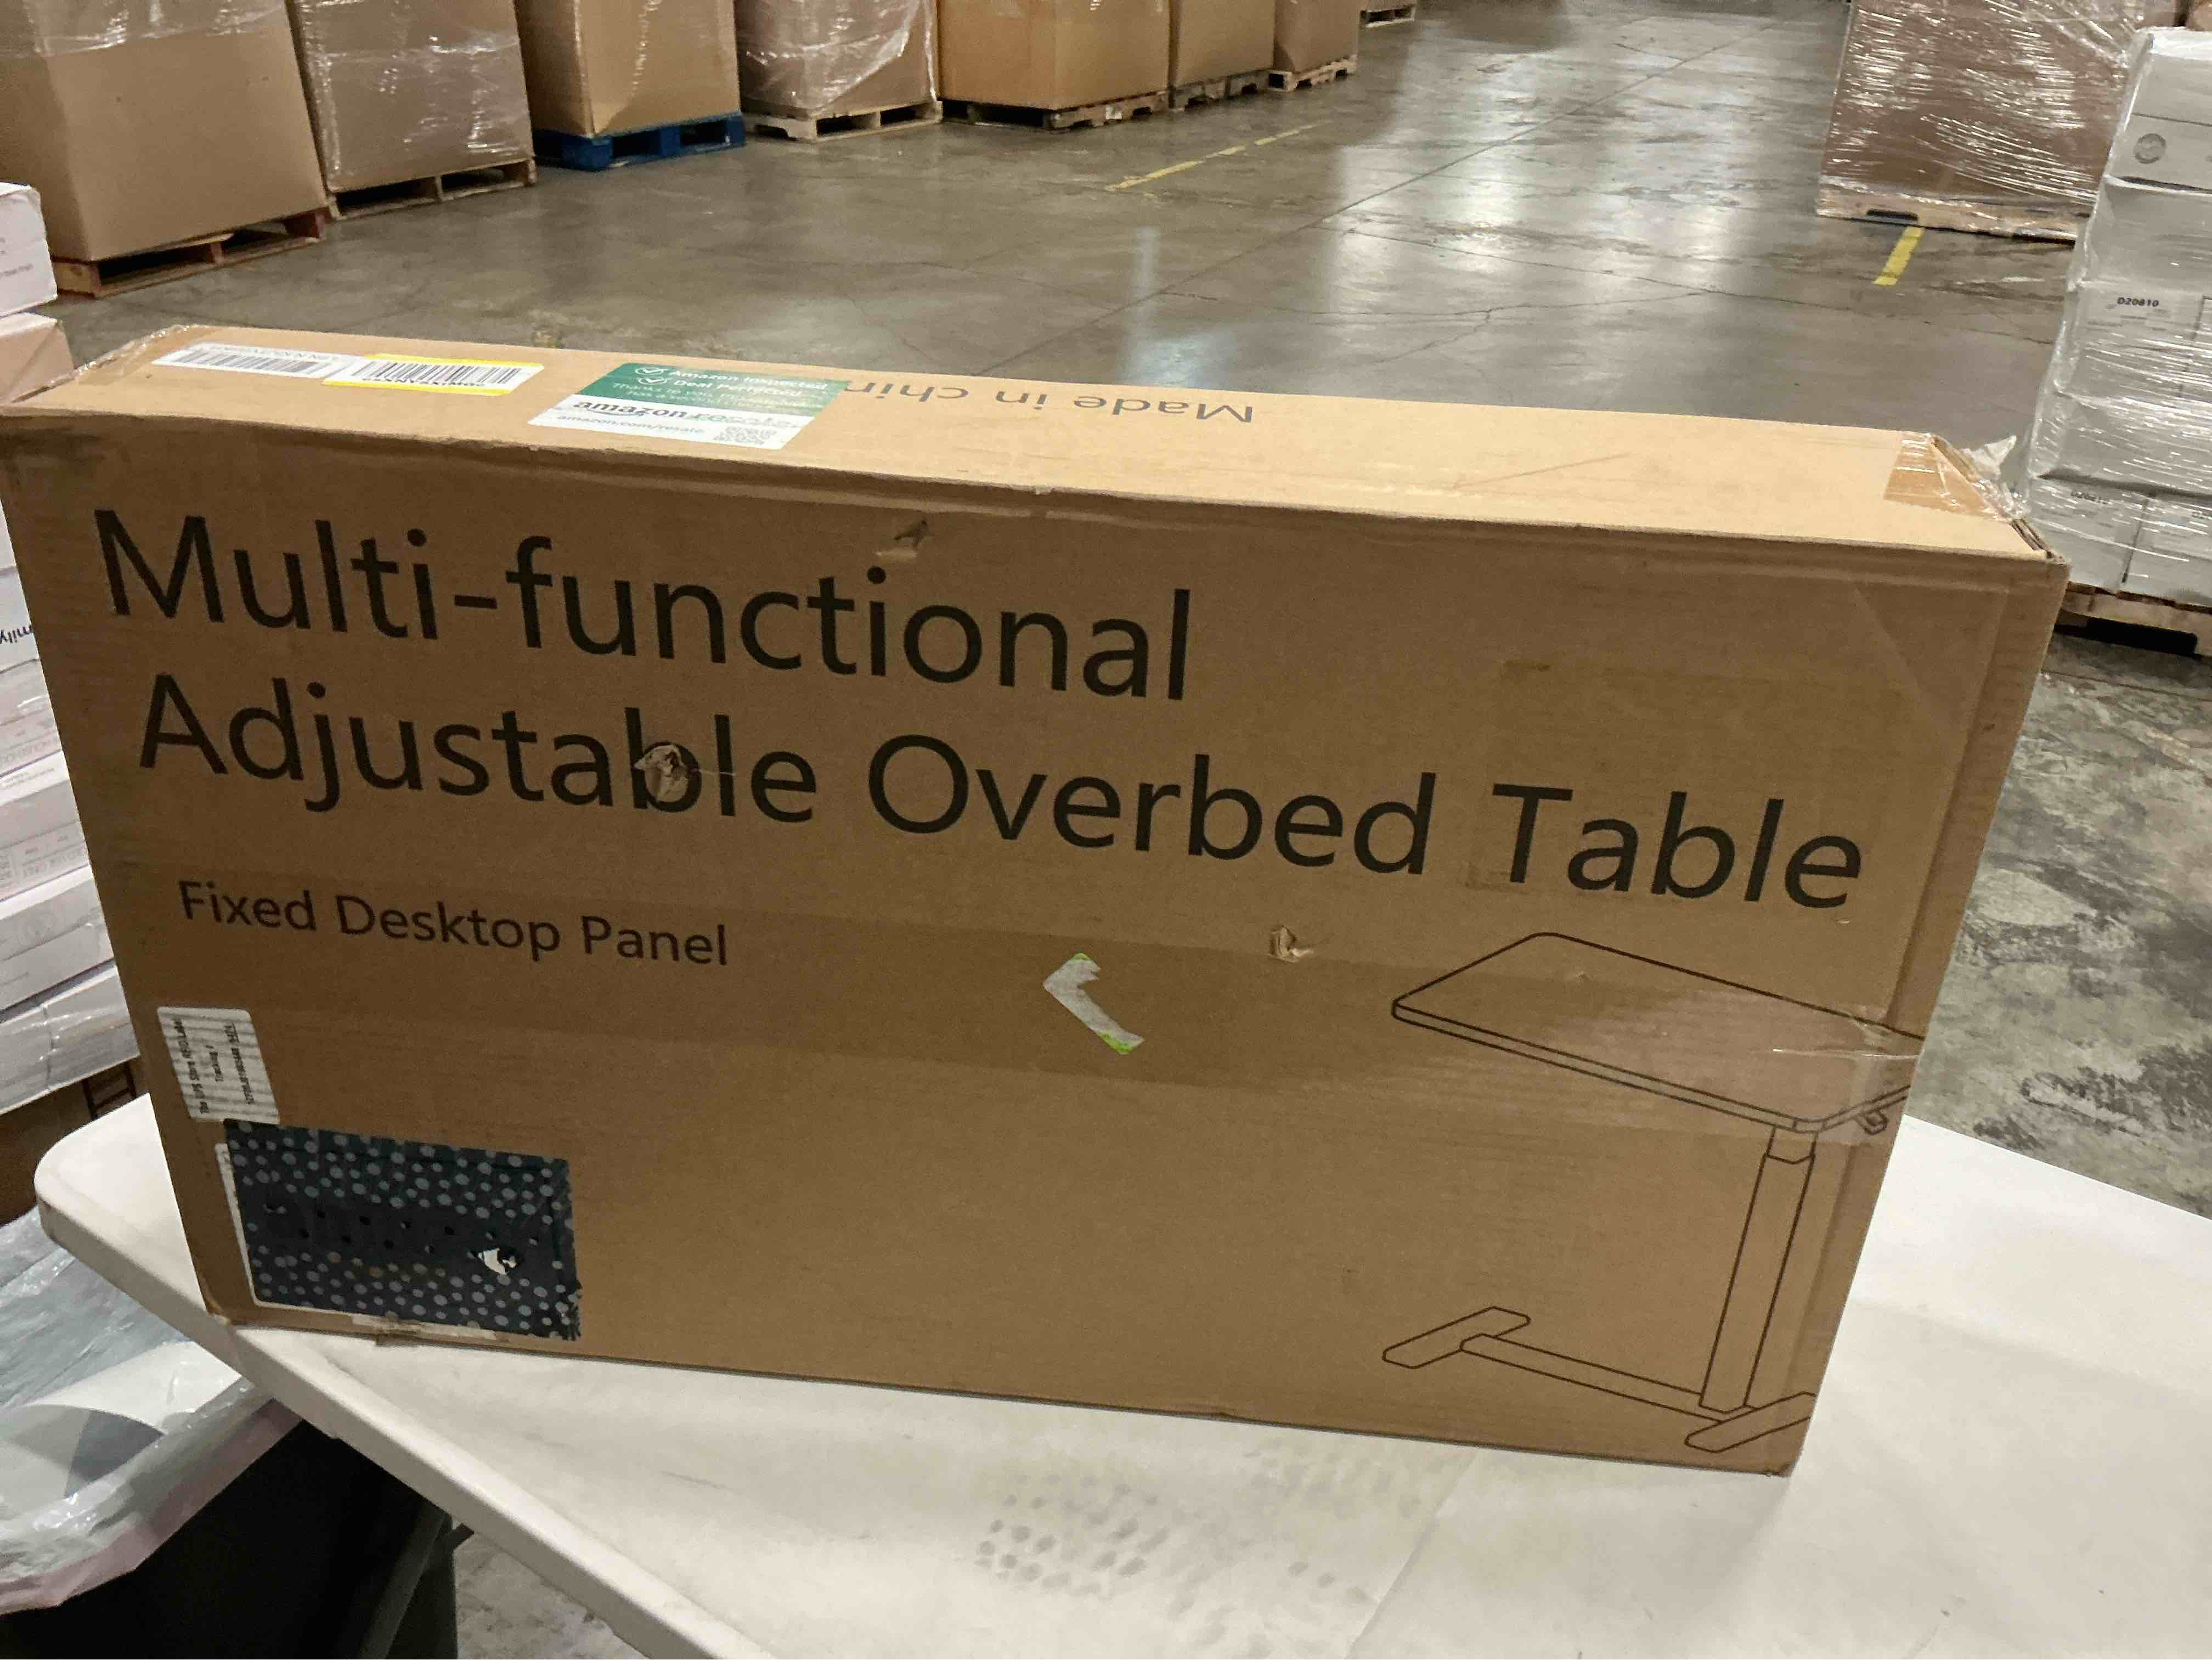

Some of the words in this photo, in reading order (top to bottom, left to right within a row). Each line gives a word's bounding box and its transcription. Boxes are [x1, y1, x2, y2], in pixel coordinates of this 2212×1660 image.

[668, 370, 738, 381] Amazon
[573, 402, 687, 418] amazon
[995, 390, 1047, 410] in
[1074, 396, 1253, 423] Made
[94, 509, 1190, 701] Multi-functional
[139, 674, 817, 824] Adjustable
[868, 734, 1436, 875] Overbed
[1491, 782, 1861, 908] Table
[178, 880, 317, 931] Fixed
[335, 895, 561, 961] Desktop
[581, 916, 728, 966] Panel
